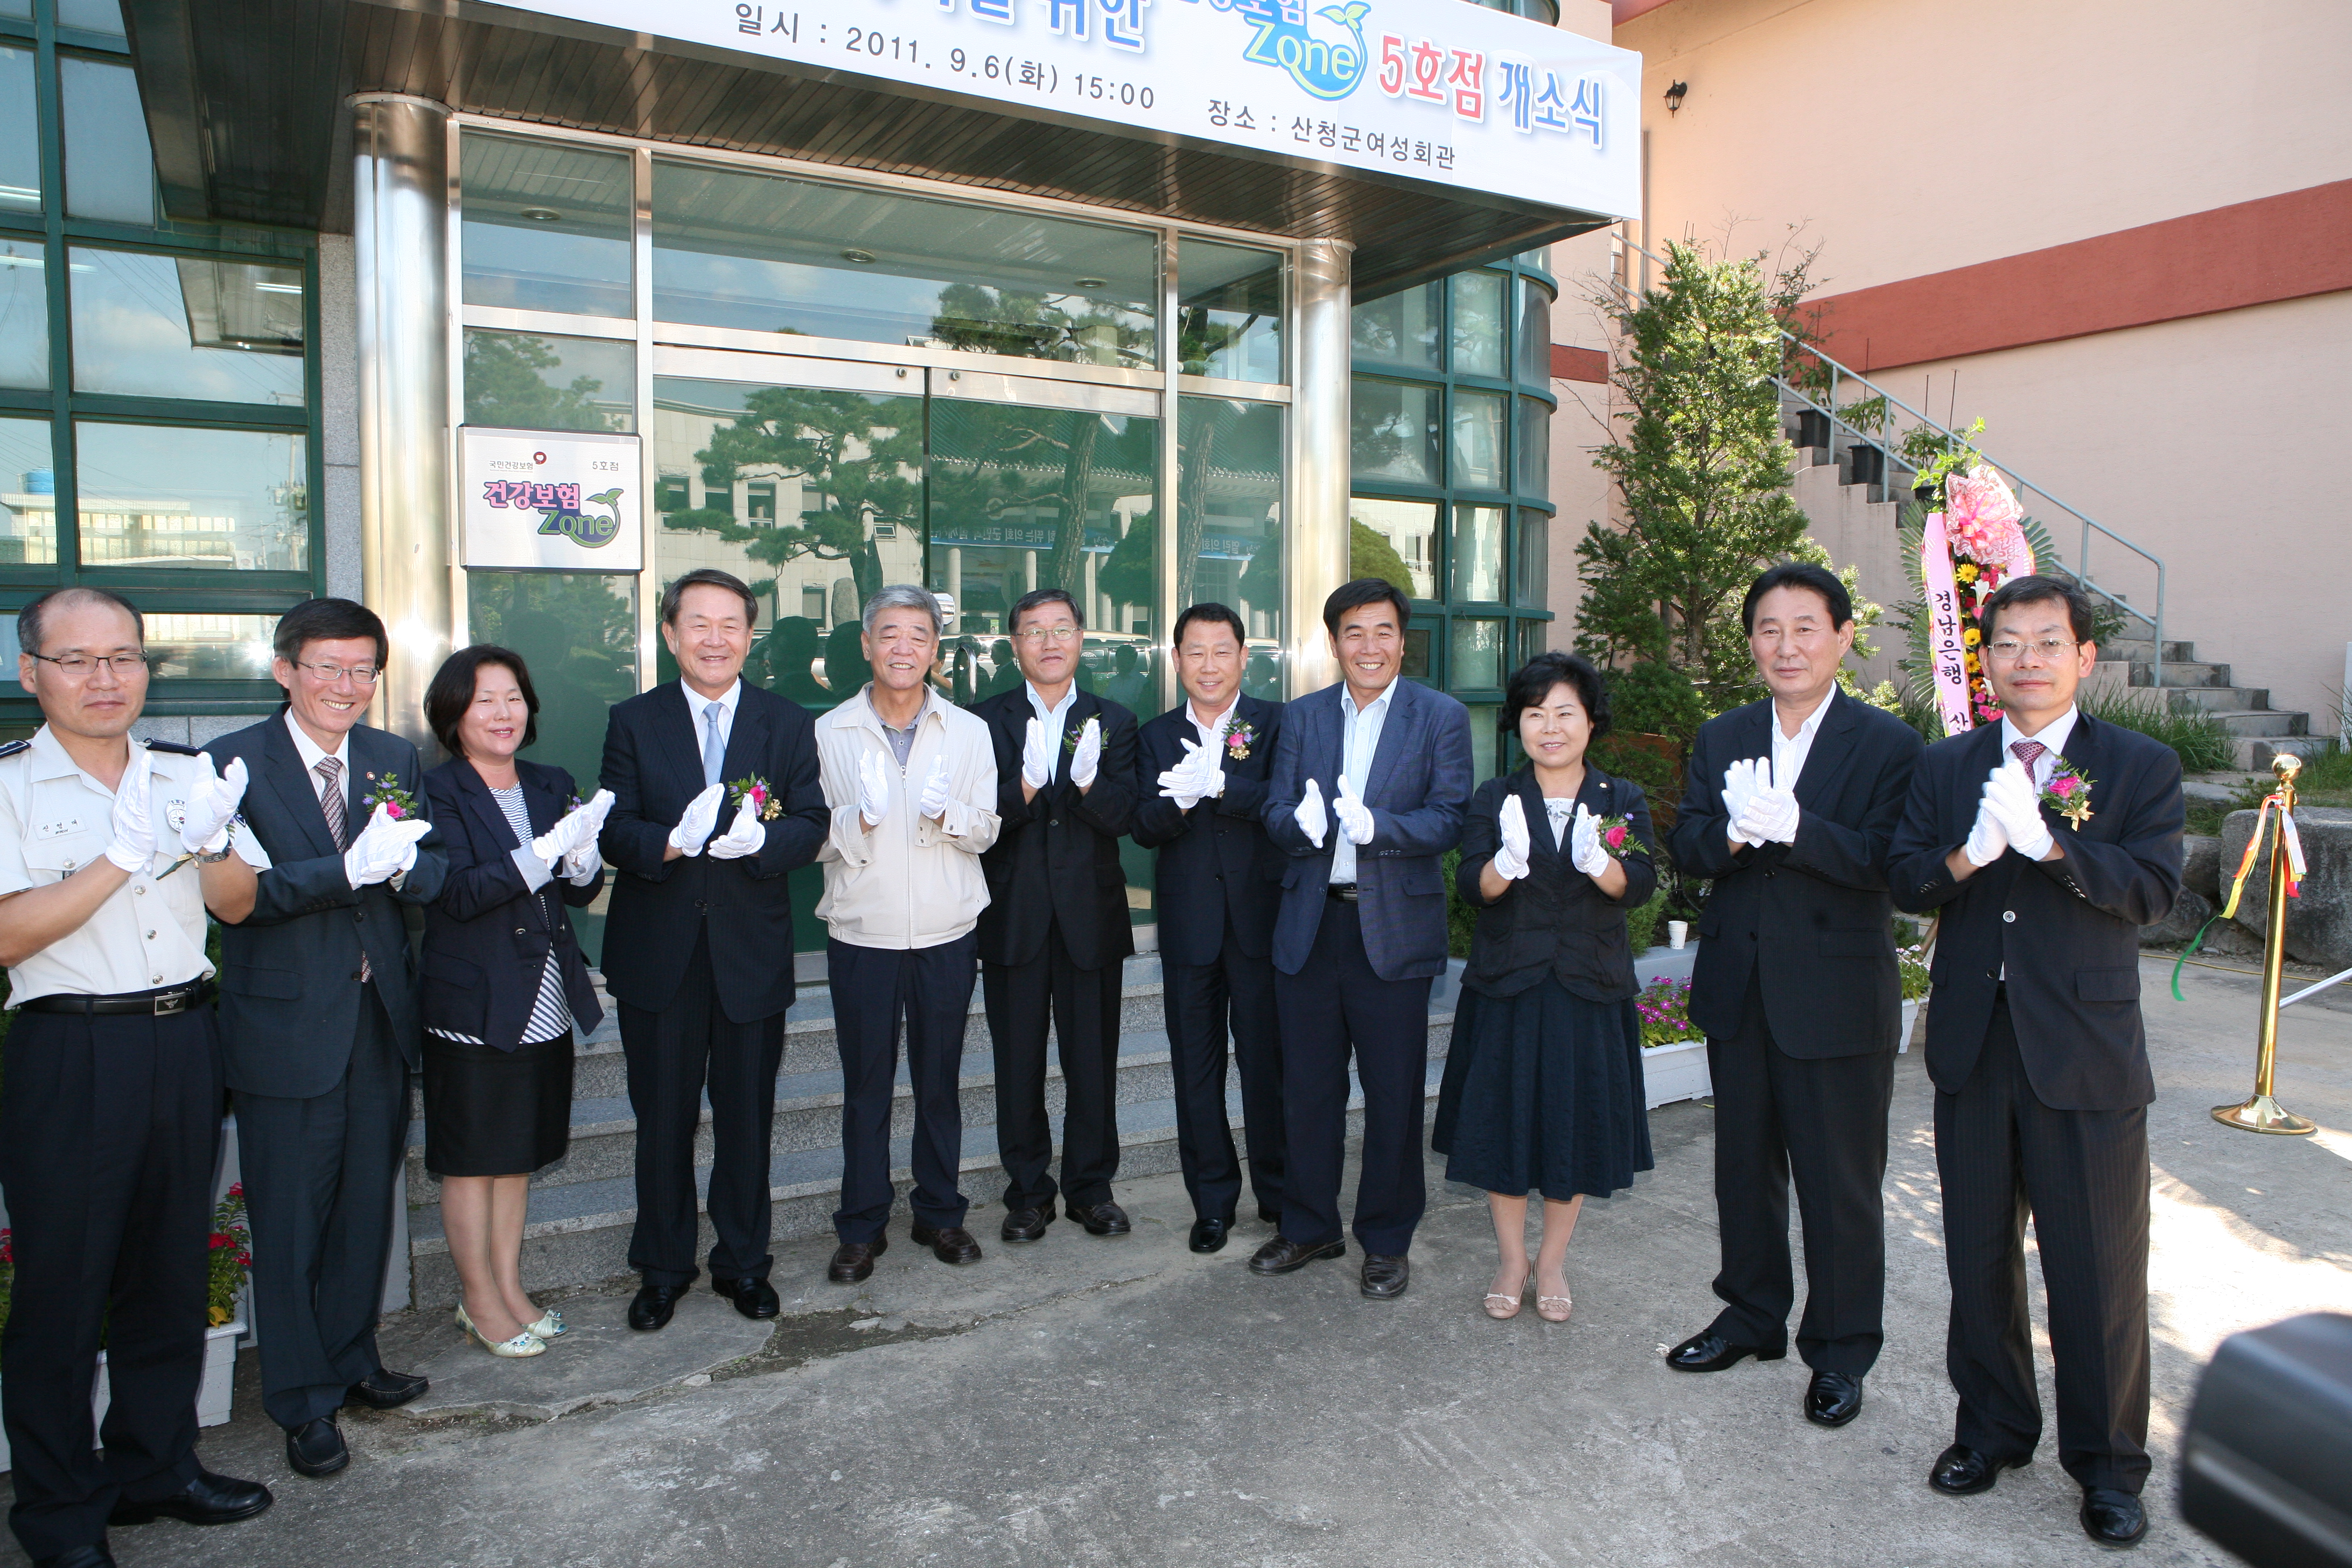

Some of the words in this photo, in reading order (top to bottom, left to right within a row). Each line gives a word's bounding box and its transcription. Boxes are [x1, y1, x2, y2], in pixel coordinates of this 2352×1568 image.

[736, 3, 798, 43] 일시
[846, 27, 932, 69] 2011.
[950, 48, 1058, 94] 9.6(화)
[1075, 74, 1154, 110] 15:00
[1245, 17, 1361, 97] Zone
[1378, 34, 1483, 120] 5호점
[1499, 61, 1602, 145] 개소식
[1208, 99, 1256, 130] 장소
[1291, 116, 1455, 171] 산청군여성회관
[483, 480, 580, 510] 건강보험
[489, 460, 534, 470] 국민건강보험
[592, 461, 619, 471] 5호점
[538, 509, 620, 548] Zone
[1935, 590, 1962, 685] 경남은행
